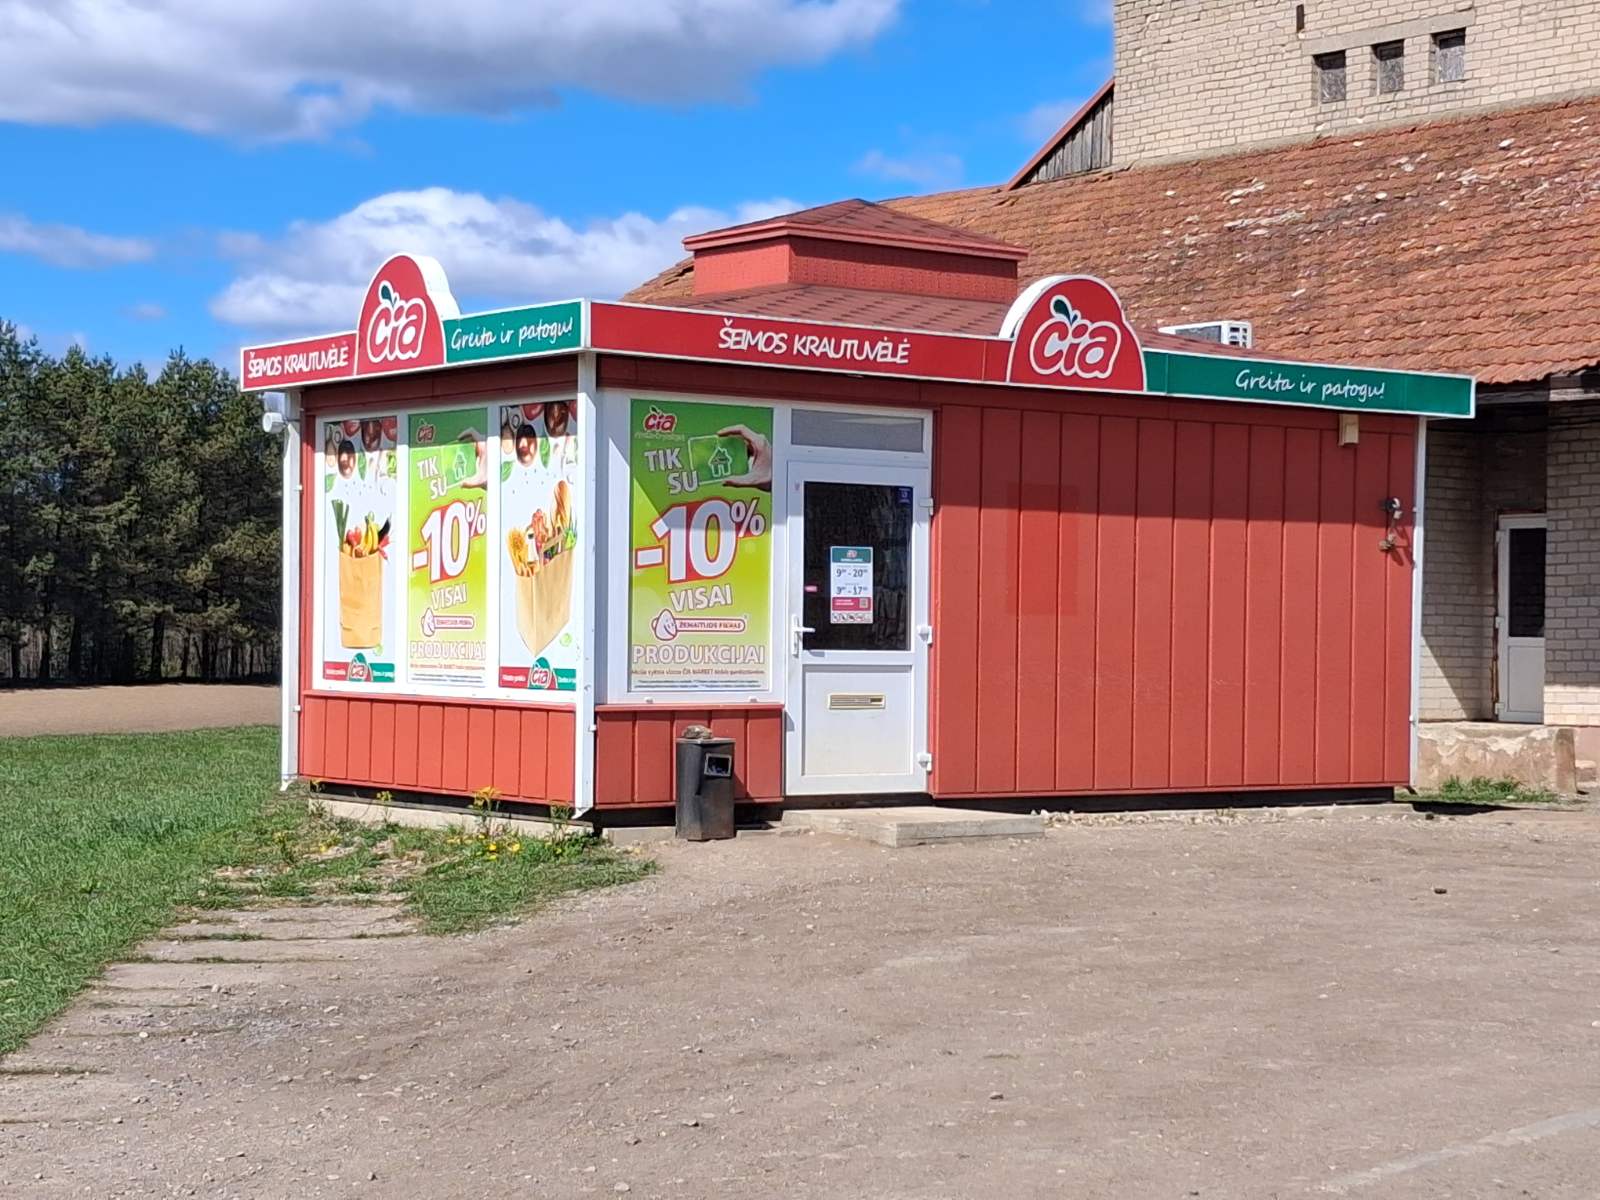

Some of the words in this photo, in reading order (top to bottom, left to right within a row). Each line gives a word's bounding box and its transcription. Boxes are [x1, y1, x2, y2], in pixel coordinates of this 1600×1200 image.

[451, 324, 497, 351] Greita
[500, 322, 515, 344] ir
[518, 316, 573, 348] patogu!
[718, 317, 788, 355] ŠEIMOS
[793, 336, 911, 364] KRAUTUVĖLĖ
[247, 351, 282, 379] ŠEIMOS
[284, 340, 349, 375] KRAUTUVĖLĖ
[1235, 369, 1296, 393] Greita
[1299, 373, 1318, 394] ir
[1321, 379, 1386, 403] patogu!
[416, 455, 440, 480] TIK
[644, 447, 683, 472] TIK
[429, 475, 447, 500] SU
[667, 470, 699, 495] SU
[430, 582, 468, 611] VISAI
[669, 584, 733, 612] VISAI
[410, 640, 487, 660] PRODUKCIJAI
[632, 644, 766, 665] PRODUKCIJAI
